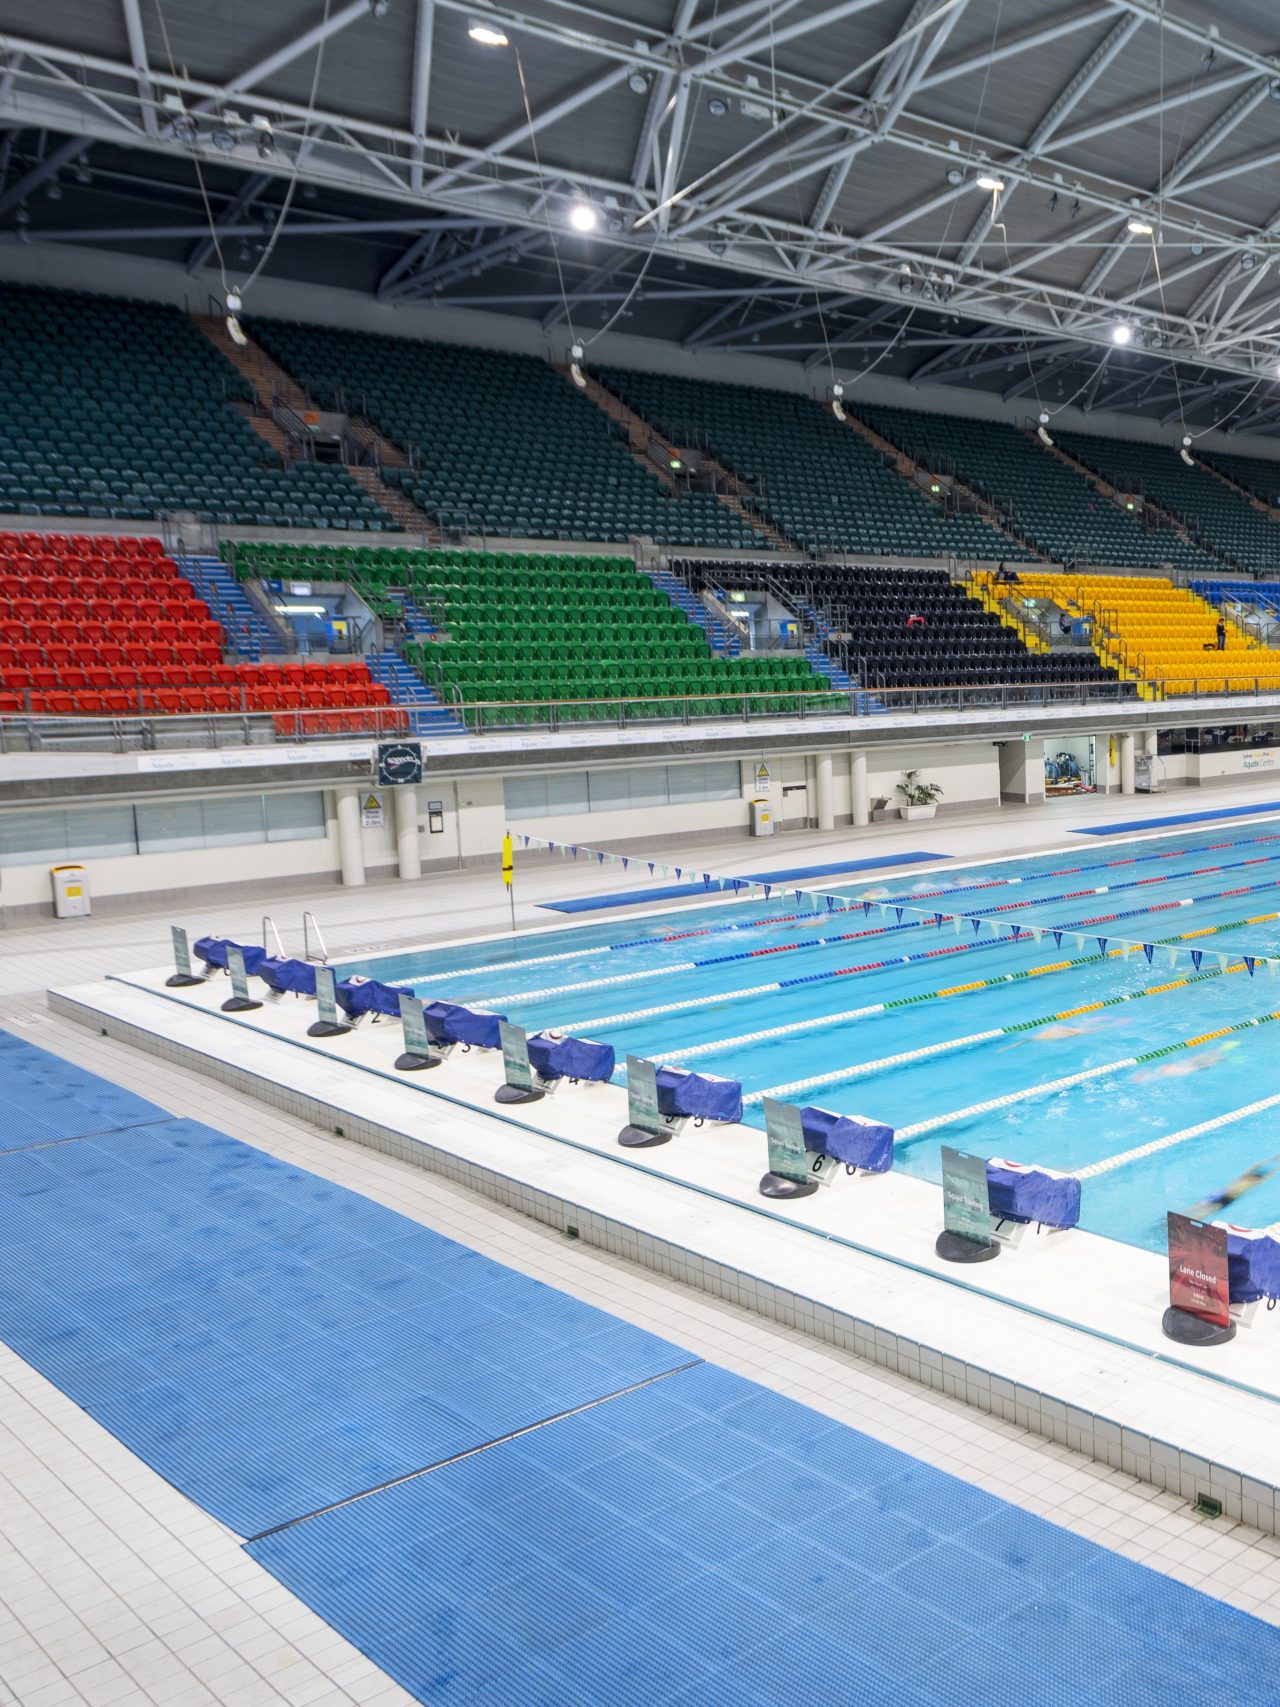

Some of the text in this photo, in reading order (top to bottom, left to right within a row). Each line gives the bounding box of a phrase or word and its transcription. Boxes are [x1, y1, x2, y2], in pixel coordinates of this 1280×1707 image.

[812, 1154, 826, 1172] 6
[947, 1191, 963, 1203] Squad
[1180, 1264, 1217, 1284] Lane Closed
